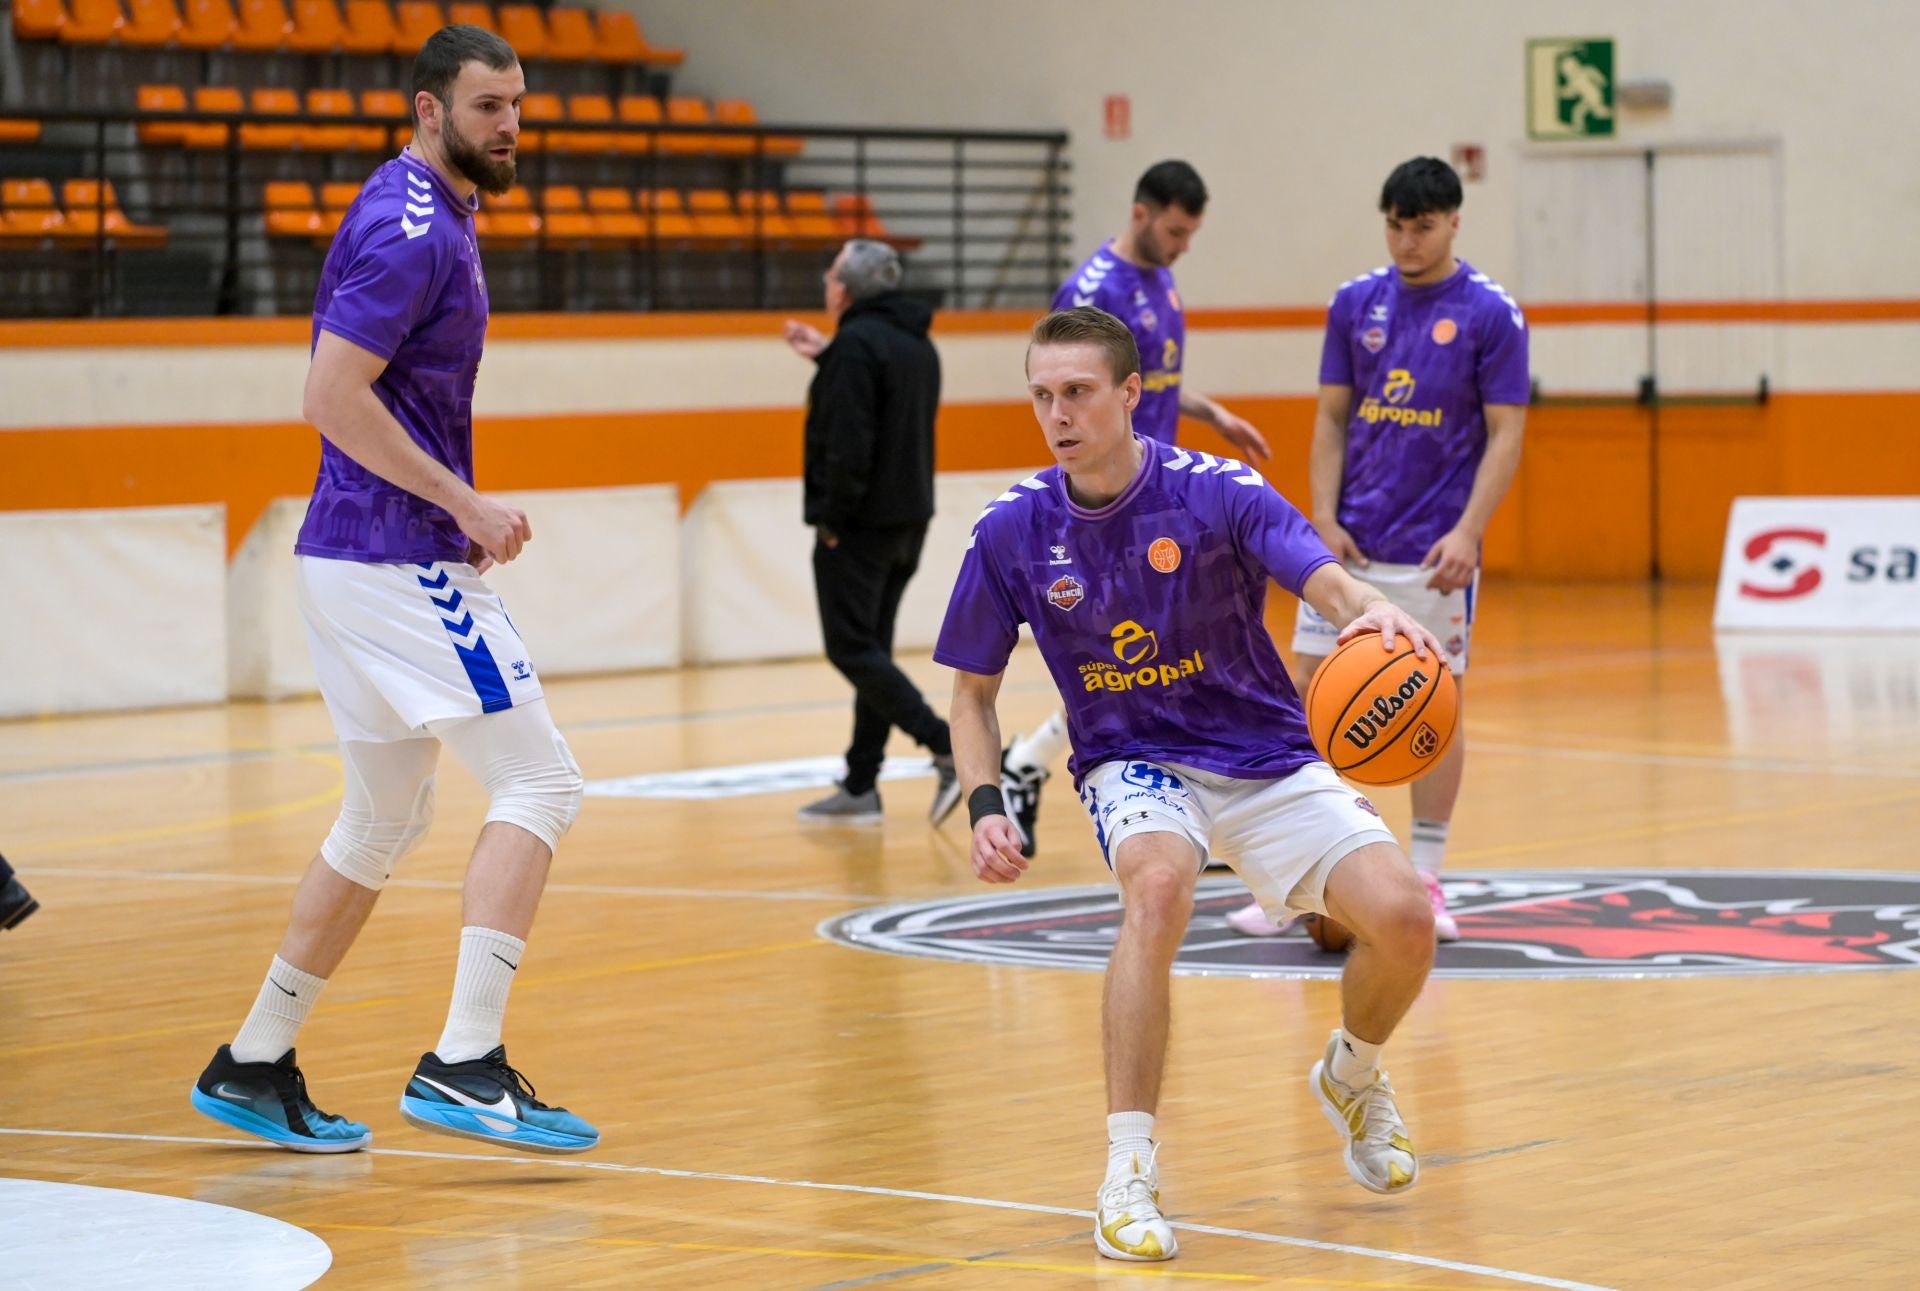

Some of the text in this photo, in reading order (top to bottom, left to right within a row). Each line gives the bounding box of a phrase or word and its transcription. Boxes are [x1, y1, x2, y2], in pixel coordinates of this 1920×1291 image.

[1049, 587, 1082, 601] PALENCIA
[1078, 660, 1118, 674] súper
[1083, 649, 1205, 692] agropal
[1343, 669, 1429, 750] Wilson
